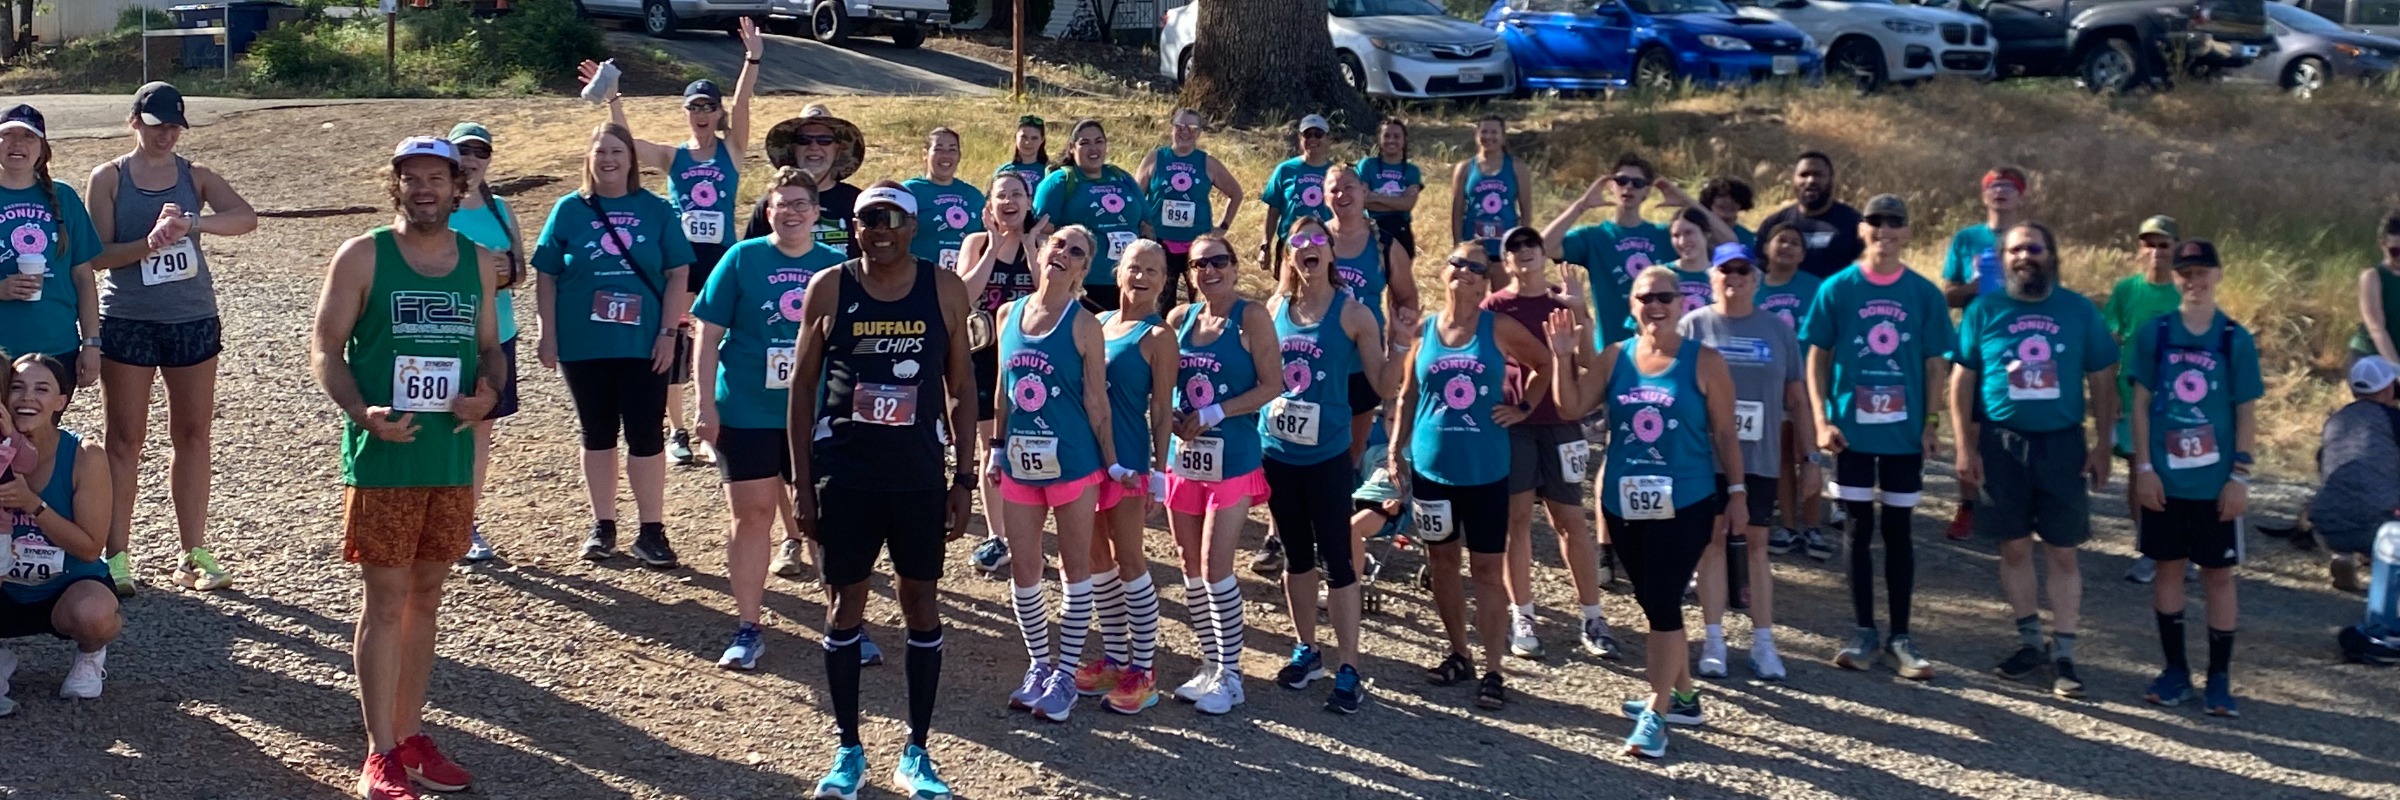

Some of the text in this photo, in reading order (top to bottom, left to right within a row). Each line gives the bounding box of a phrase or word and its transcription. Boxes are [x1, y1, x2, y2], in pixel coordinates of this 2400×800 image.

[681, 169, 725, 181] DONUTS
[1167, 209, 1188, 221] 894
[690, 222, 716, 236] 695
[150, 252, 188, 275] 790
[767, 273, 811, 284] DONU
[1338, 270, 1367, 287] NUTS
[607, 302, 626, 320] 81
[1858, 306, 1907, 321] DONUTS
[853, 321, 927, 336] BUFFALO
[2008, 321, 2060, 335] DONUTS
[874, 338, 925, 353] CHIPS
[1281, 341, 1323, 358] ONUTS
[1006, 356, 1054, 374] DONUTS
[1180, 357, 1222, 372] ONUTS
[1429, 359, 1486, 374] DONUTS
[2023, 370, 2044, 388] 94
[407, 376, 448, 400] 680
[1617, 391, 1675, 407] DONUTS
[1872, 394, 1891, 412] 92
[873, 397, 898, 421] 82
[1276, 414, 1309, 434] 687
[2181, 437, 2202, 456] 93
[1021, 452, 1043, 470] 65
[1182, 450, 1213, 471] 589
[1630, 491, 1663, 510] 692
[24, 547, 57, 556] SYNERGY
